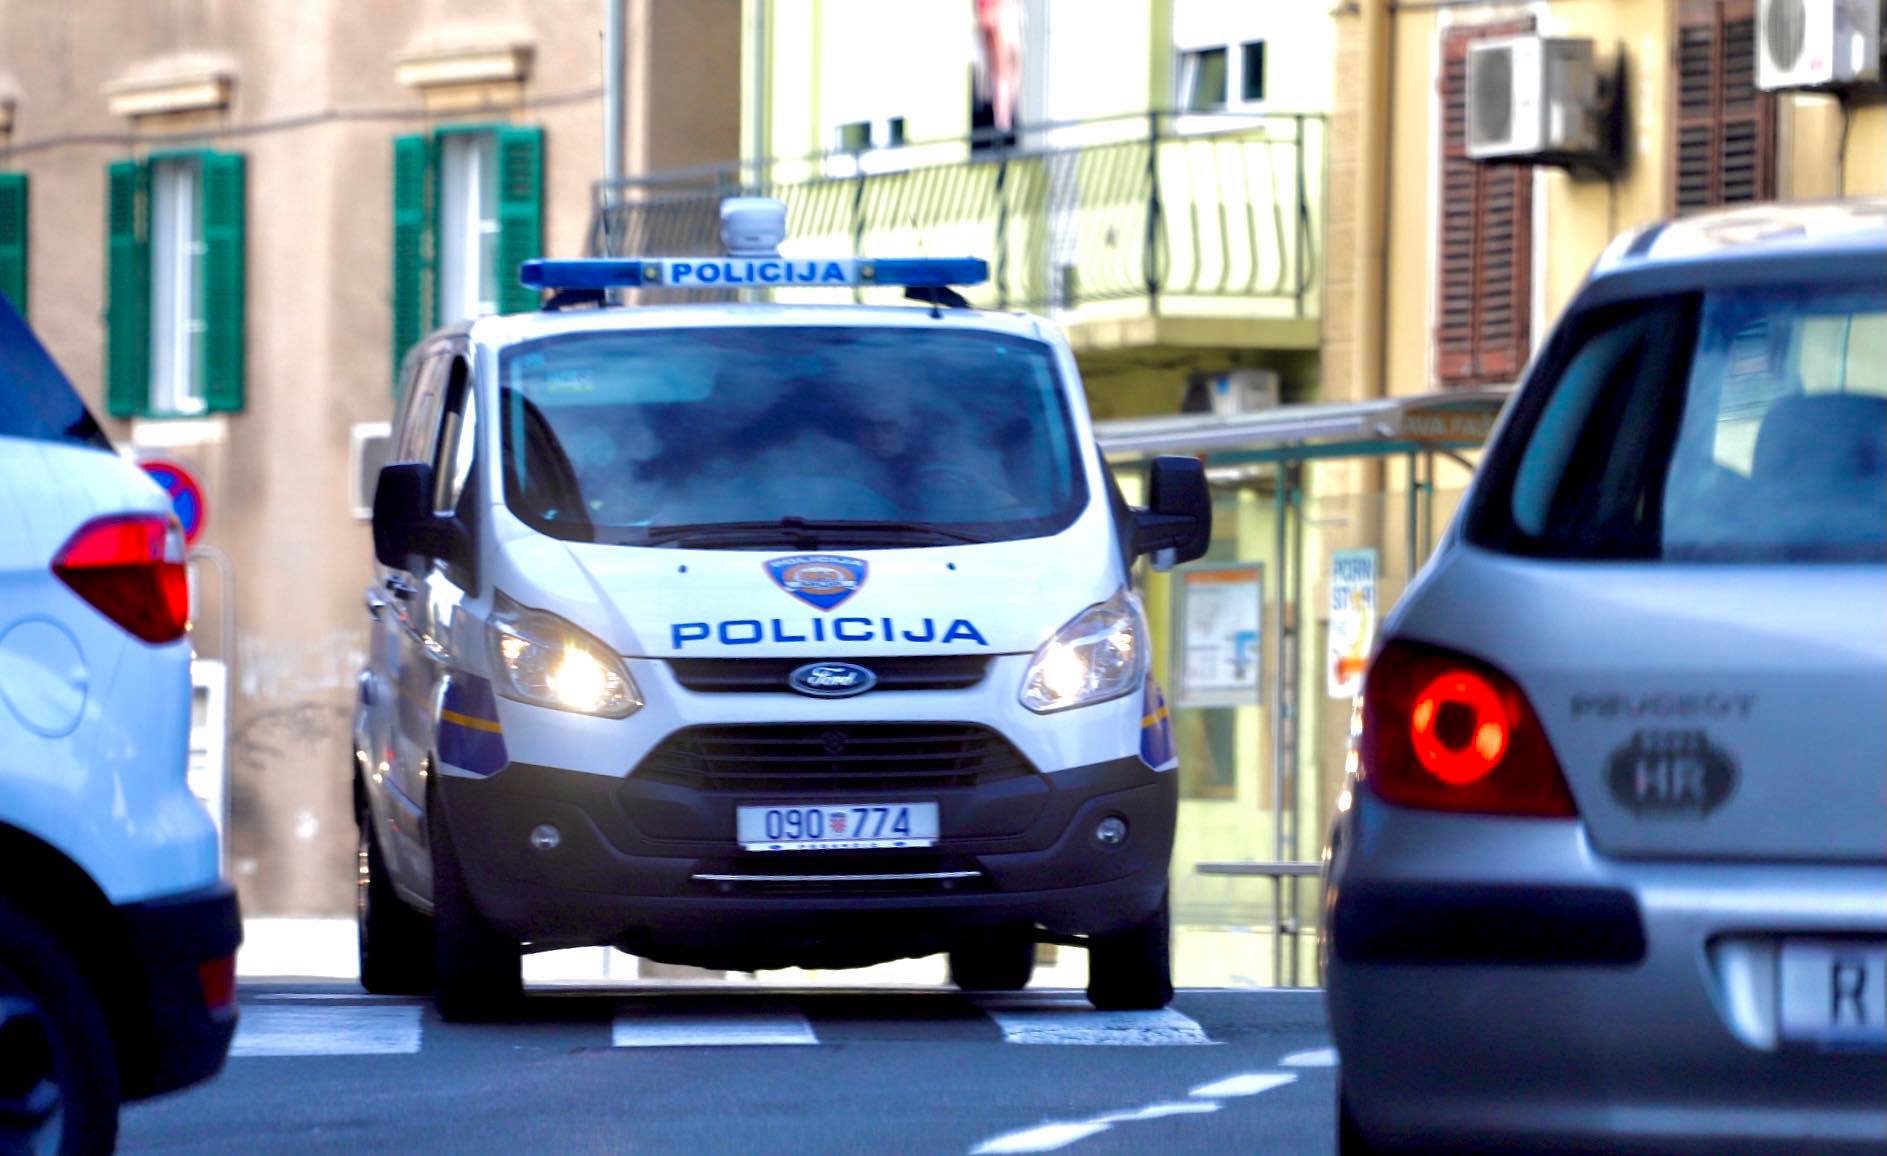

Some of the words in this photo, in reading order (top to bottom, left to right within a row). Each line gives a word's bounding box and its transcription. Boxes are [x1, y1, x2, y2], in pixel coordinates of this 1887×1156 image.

[671, 261, 846, 284] POLICIJA
[671, 617, 989, 650] POLICIJA
[765, 808, 825, 840] 090
[851, 807, 911, 837] 774
